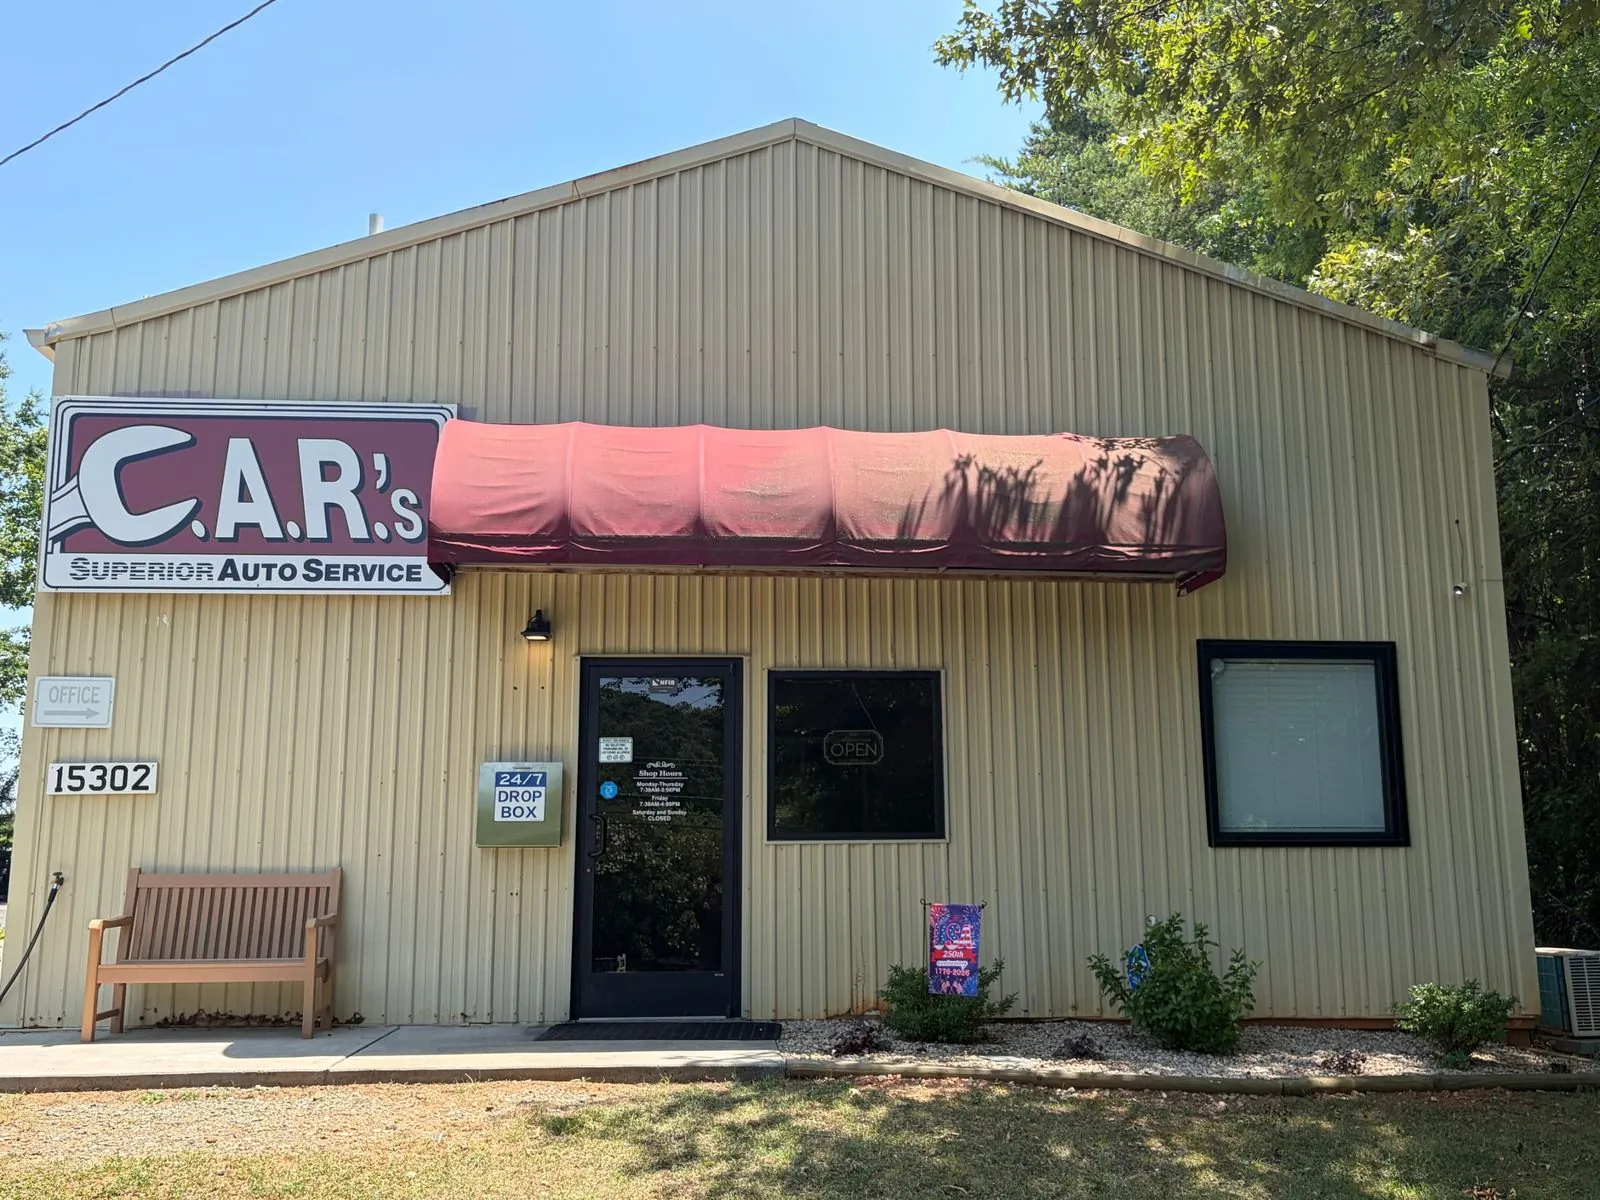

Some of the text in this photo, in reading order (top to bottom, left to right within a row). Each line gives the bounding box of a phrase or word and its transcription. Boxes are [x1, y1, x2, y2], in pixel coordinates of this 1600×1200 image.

[69, 557, 423, 583] SUPERIOR AUTO SERVICE
[49, 685, 101, 704] OFFICE
[831, 742, 877, 757] OPEN
[54, 764, 151, 793] 15302
[499, 773, 543, 785] 24/7
[638, 769, 683, 778] Shop Hours
[498, 790, 542, 803] DROP
[501, 806, 537, 819] BOX
[943, 950, 964, 958] 250th
[935, 967, 970, 977] 1776-2026
